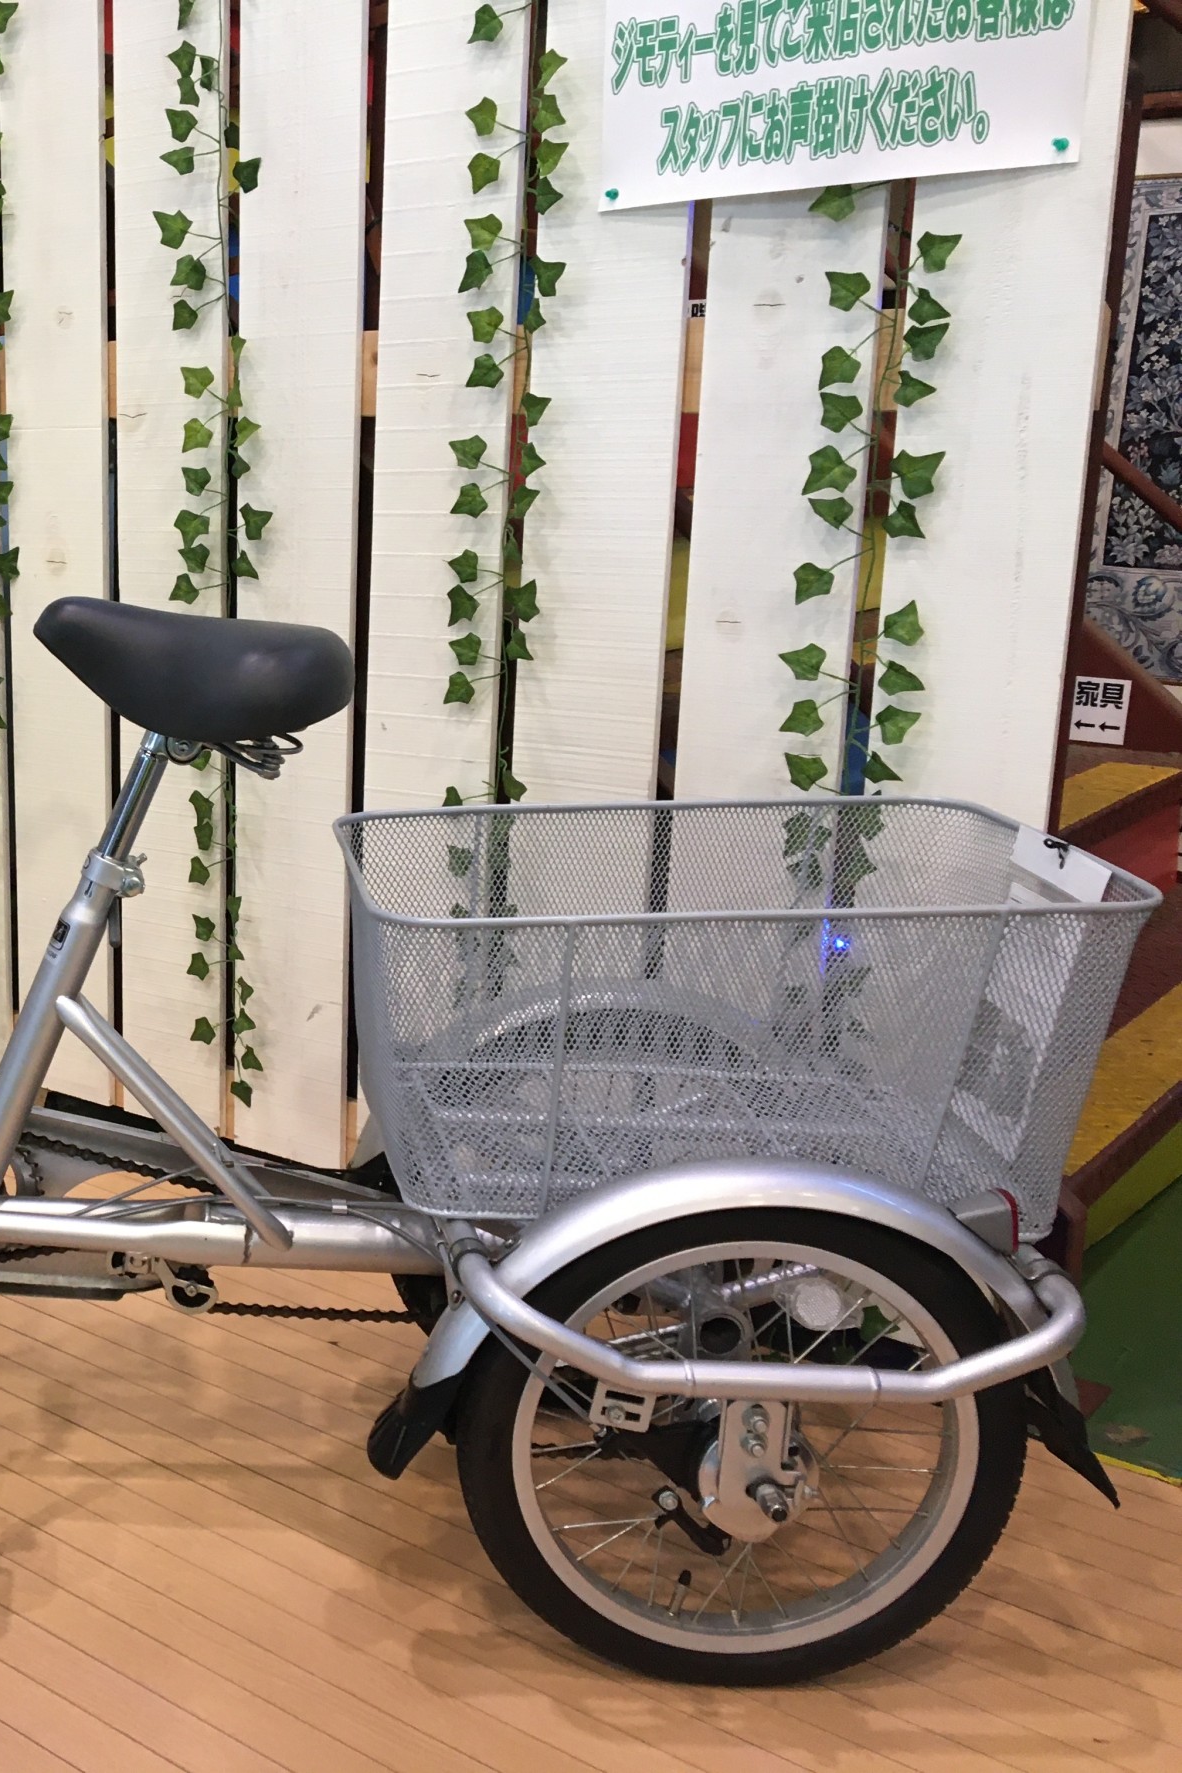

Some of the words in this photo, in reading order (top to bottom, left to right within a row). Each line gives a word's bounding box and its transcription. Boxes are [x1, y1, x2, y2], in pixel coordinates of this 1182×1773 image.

[657, 66, 990, 176] スタッフにお声掛けください。
[1075, 681, 1125, 709] 家具
